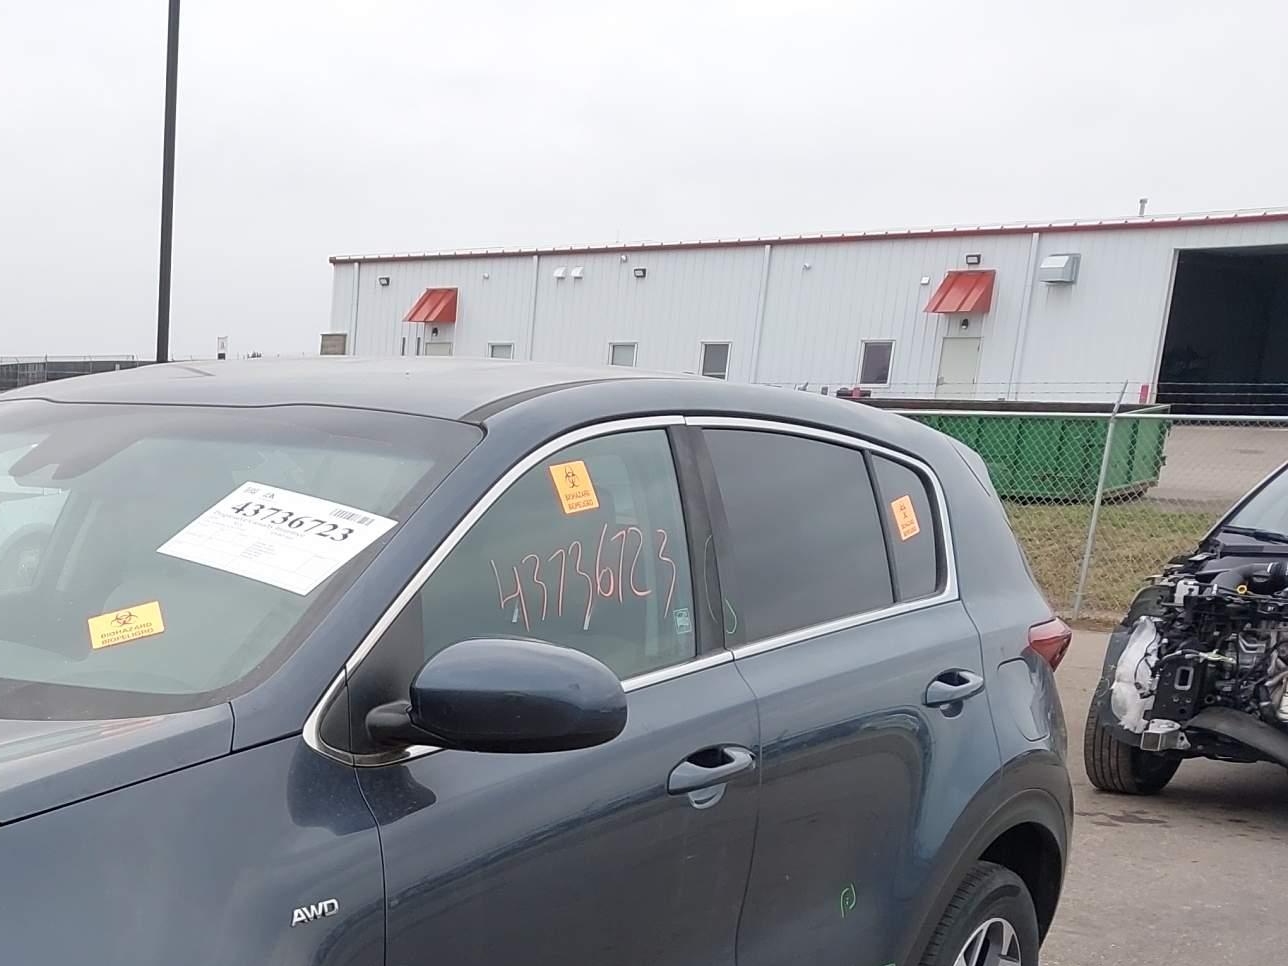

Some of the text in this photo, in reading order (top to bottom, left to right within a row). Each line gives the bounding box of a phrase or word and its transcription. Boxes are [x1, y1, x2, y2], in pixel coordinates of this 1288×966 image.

[231, 501, 355, 542] 43736723
[490, 523, 676, 632] 43736723
[101, 622, 153, 639] BIOHAZARD
[292, 899, 339, 927] AWD
